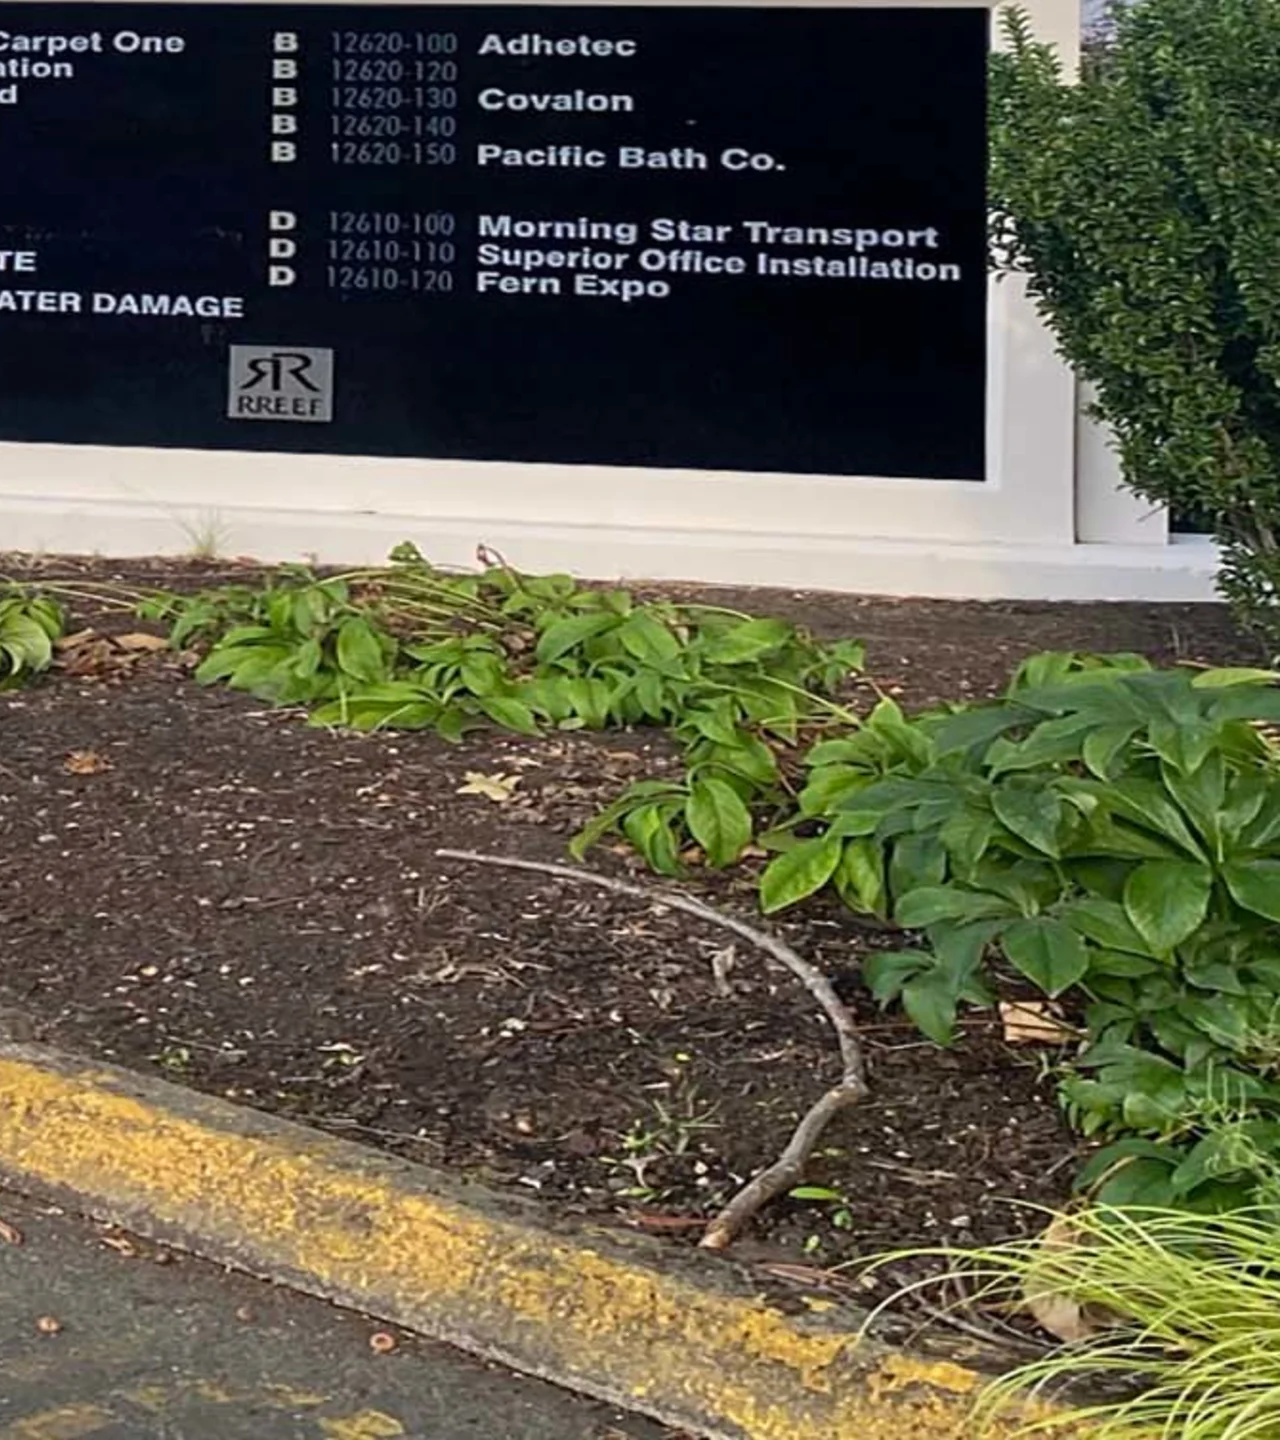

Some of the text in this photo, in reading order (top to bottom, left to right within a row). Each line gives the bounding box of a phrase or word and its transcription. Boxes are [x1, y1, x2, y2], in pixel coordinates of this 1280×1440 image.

[112, 31, 185, 53] One
[272, 32, 637, 57] B 12620-100 Adhetec
[272, 59, 458, 81] B 12620-120
[272, 86, 634, 111] B 12620-130 Covalon
[271, 114, 457, 136] B 12620-140
[271, 141, 786, 171] B 12620-150 Pacific Bath Co.
[269, 210, 939, 252] D 12610-100 Morning Star Transport
[269, 238, 961, 281] D 12610-110 Superior Office Installation
[269, 265, 670, 302] D 12610-120 Fern Expo
[92, 292, 244, 318] DAMAGE
[238, 395, 323, 417] RREEF
